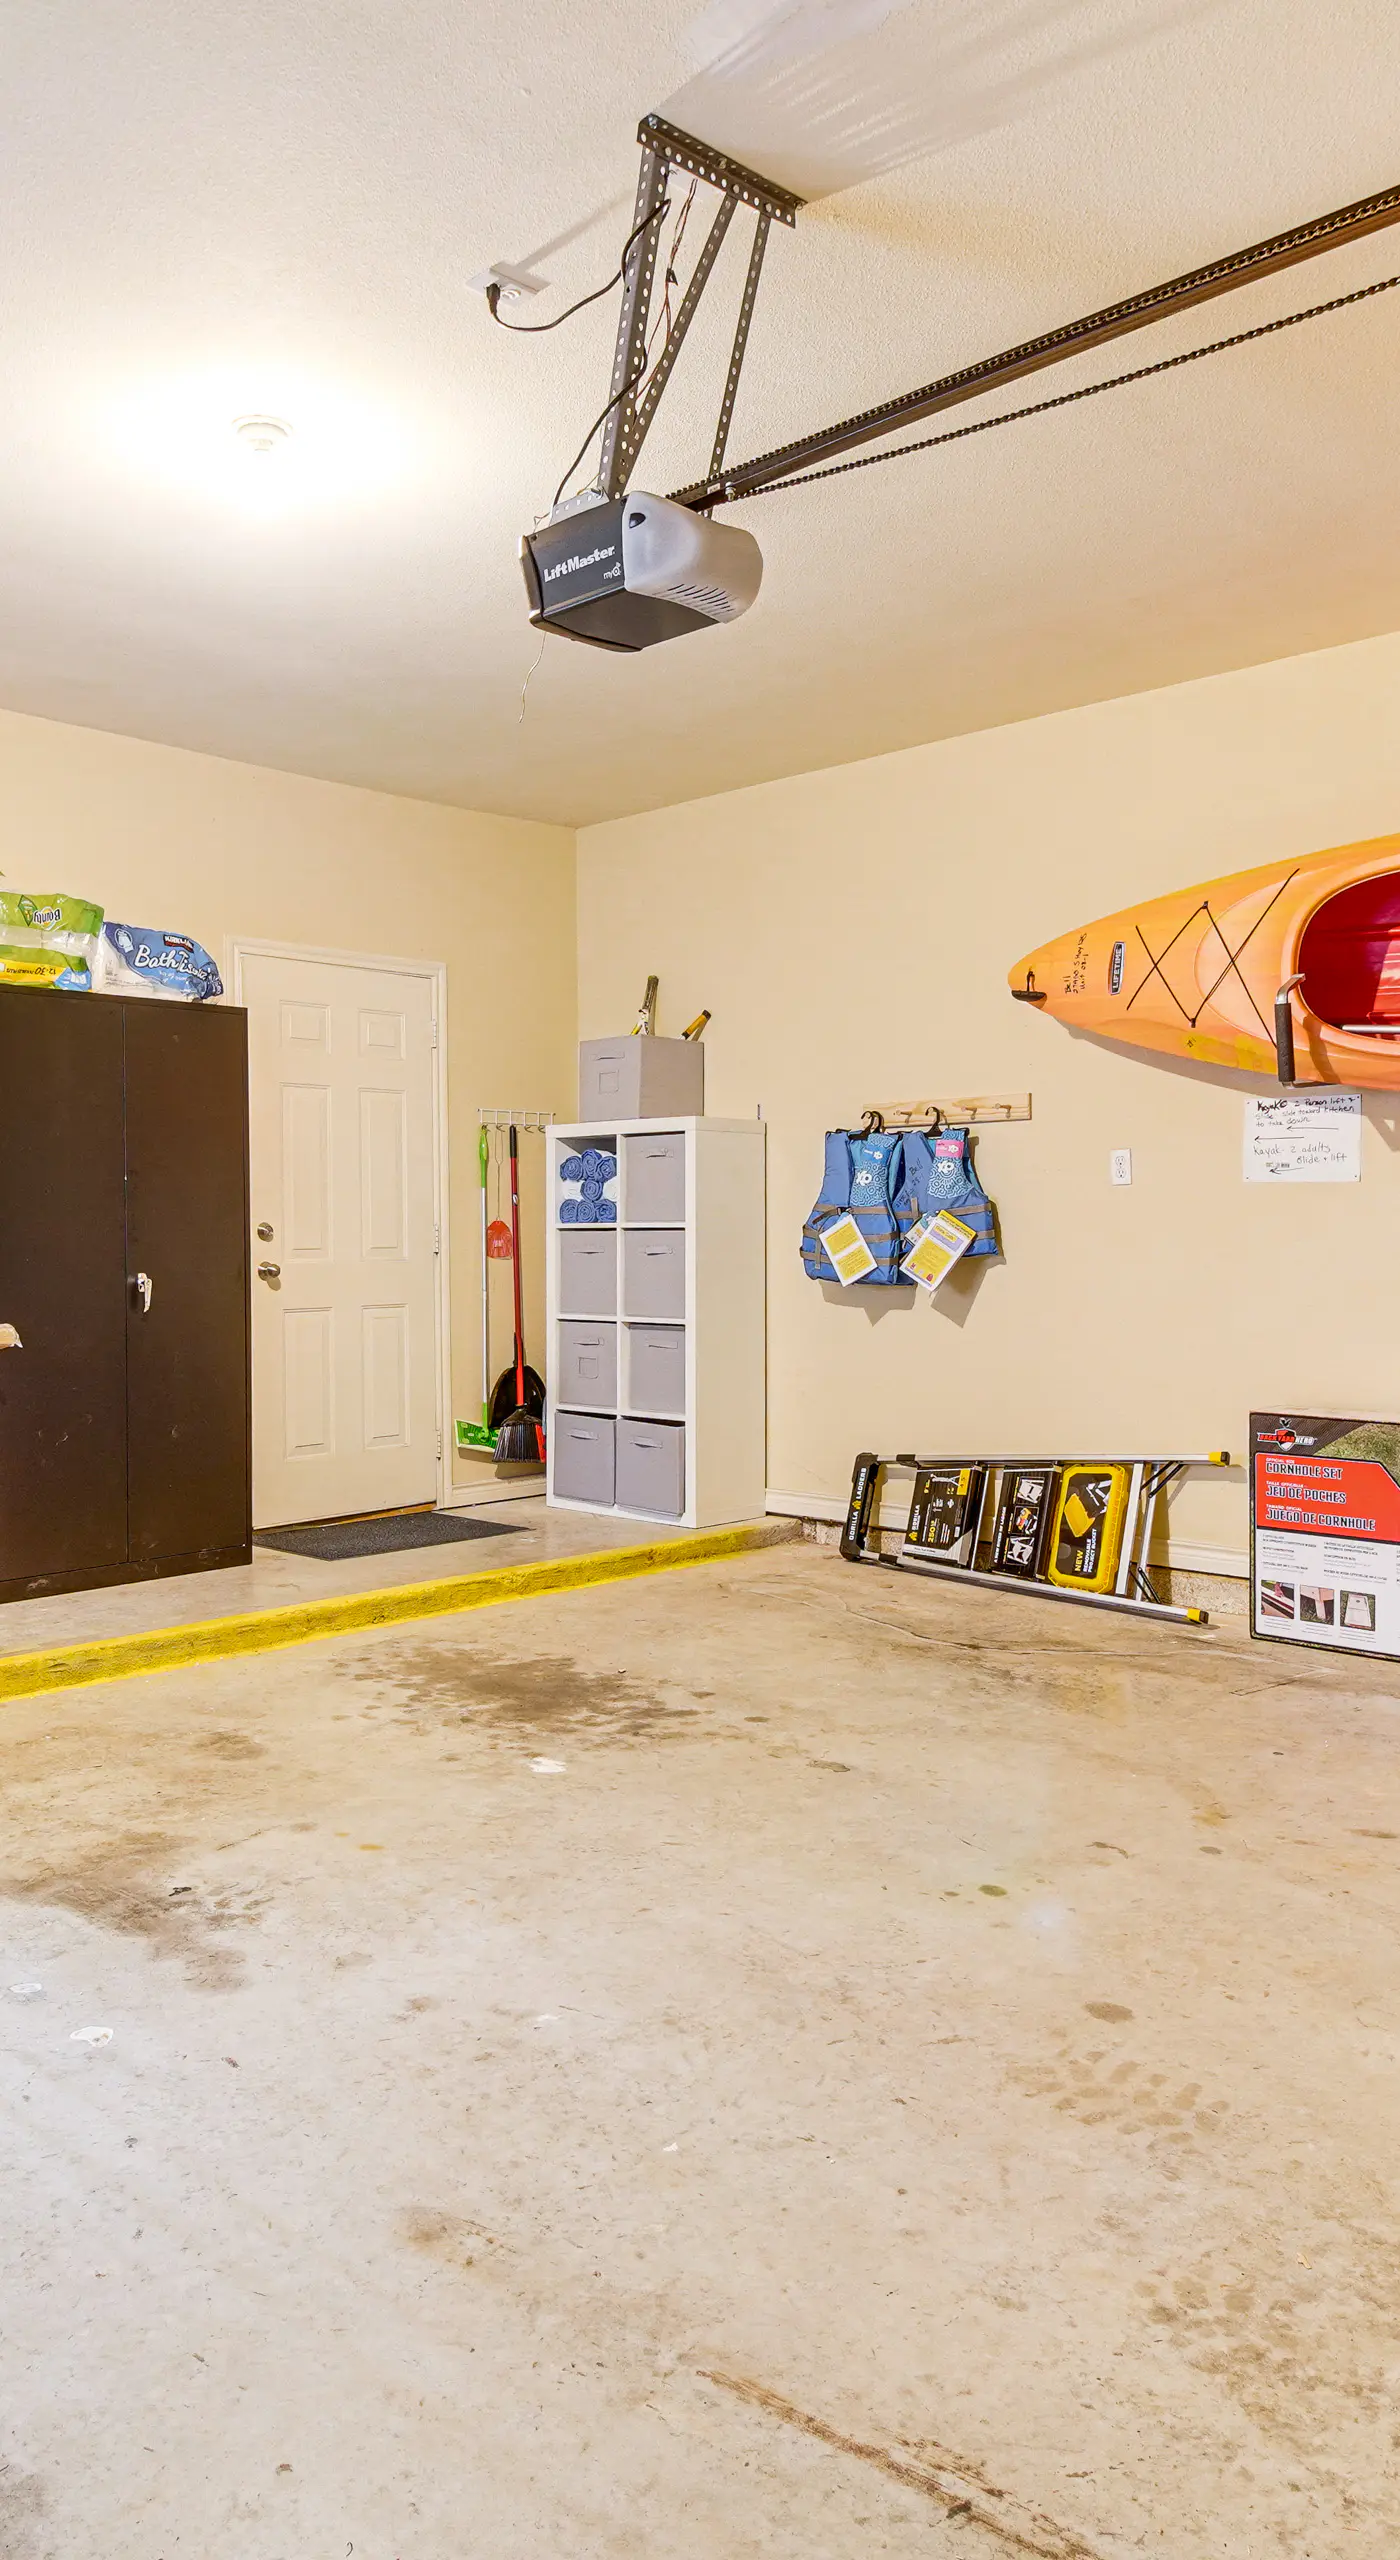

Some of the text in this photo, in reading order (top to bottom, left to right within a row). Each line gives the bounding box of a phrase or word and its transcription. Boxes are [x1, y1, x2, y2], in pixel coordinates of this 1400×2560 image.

[544, 546, 615, 582] LiftMaster
[33, 908, 62, 924] Bounty
[134, 945, 178, 968] Bath
[35, 967, 45, 976] 30
[1113, 948, 1122, 989] LIFETIME
[1291, 1145, 1297, 1153] 2
[1302, 1142, 1331, 1153] adults
[1331, 1152, 1347, 1162] lift
[1266, 1462, 1343, 1479] CORNHOLE SET
[849, 1467, 867, 1541] GORILLA LADDERS
[1266, 1485, 1346, 1504] JEU DE POCHES
[912, 1504, 920, 1531] GORILLA
[1266, 1509, 1376, 1531] JUEGO DE CORNHOLE
[928, 1526, 936, 1543] 250
[1075, 1550, 1083, 1572] NEW
[1083, 1539, 1091, 1572] REMOVABLE
